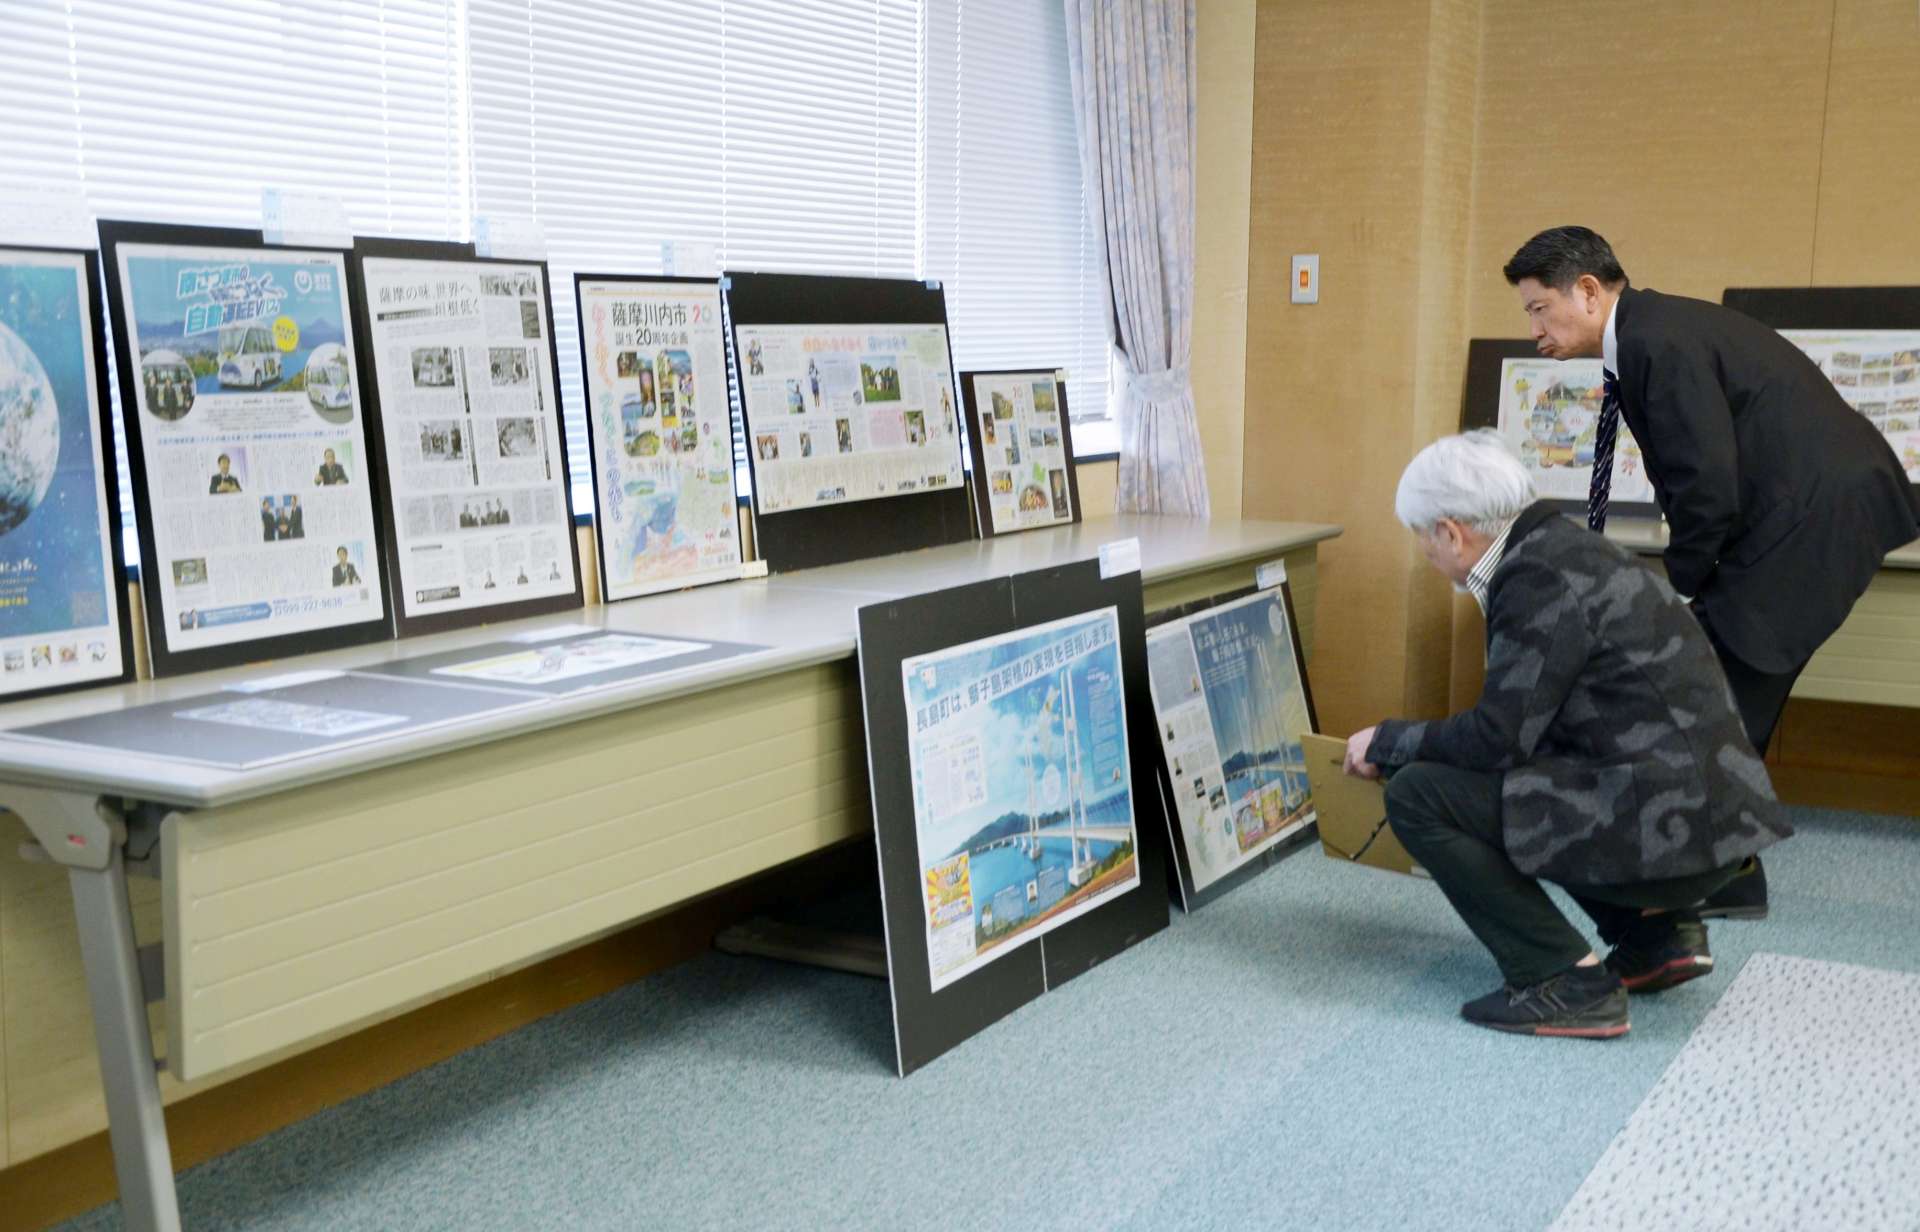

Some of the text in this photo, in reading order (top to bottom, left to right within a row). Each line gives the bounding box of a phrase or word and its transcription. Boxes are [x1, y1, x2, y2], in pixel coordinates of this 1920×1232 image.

[612, 302, 687, 327] 薩摩川内市
